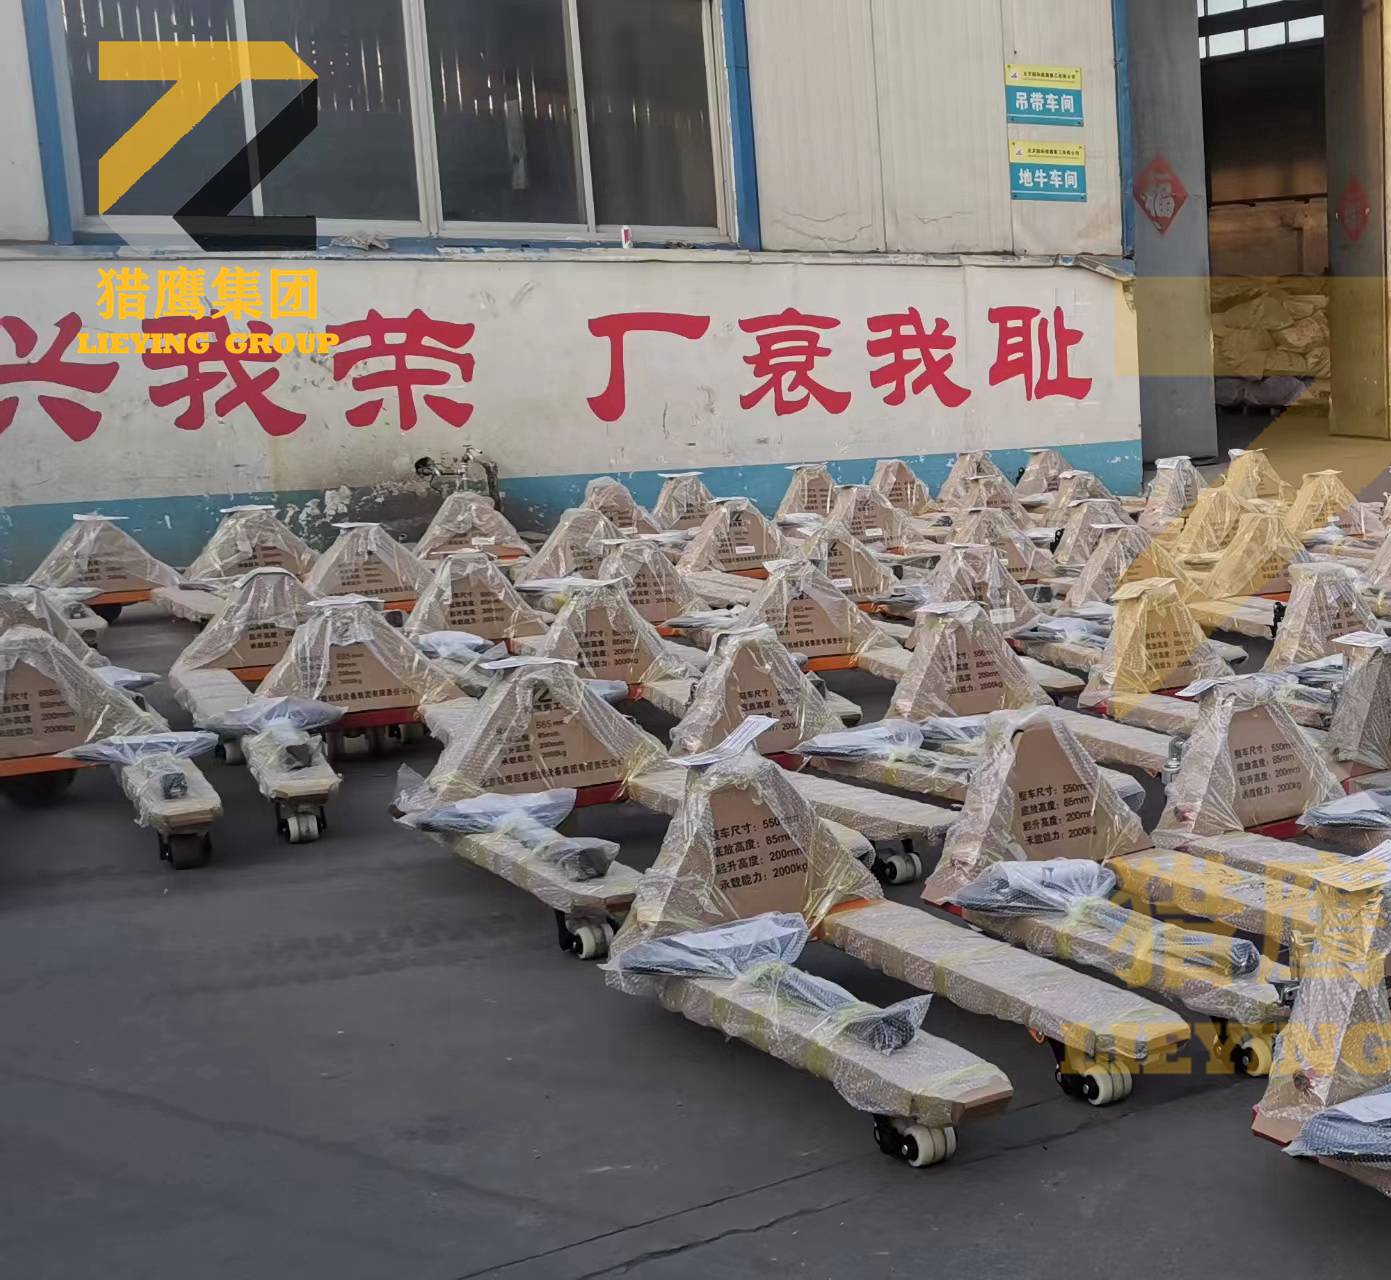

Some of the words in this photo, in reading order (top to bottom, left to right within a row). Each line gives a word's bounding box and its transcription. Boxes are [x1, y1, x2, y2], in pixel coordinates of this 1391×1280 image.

[1015, 91, 1074, 113] 吊带车间
[1018, 168, 1078, 189] 地牛车间
[587, 306, 1093, 422] 厂衰我耻
[772, 861, 808, 879] 2000kg
